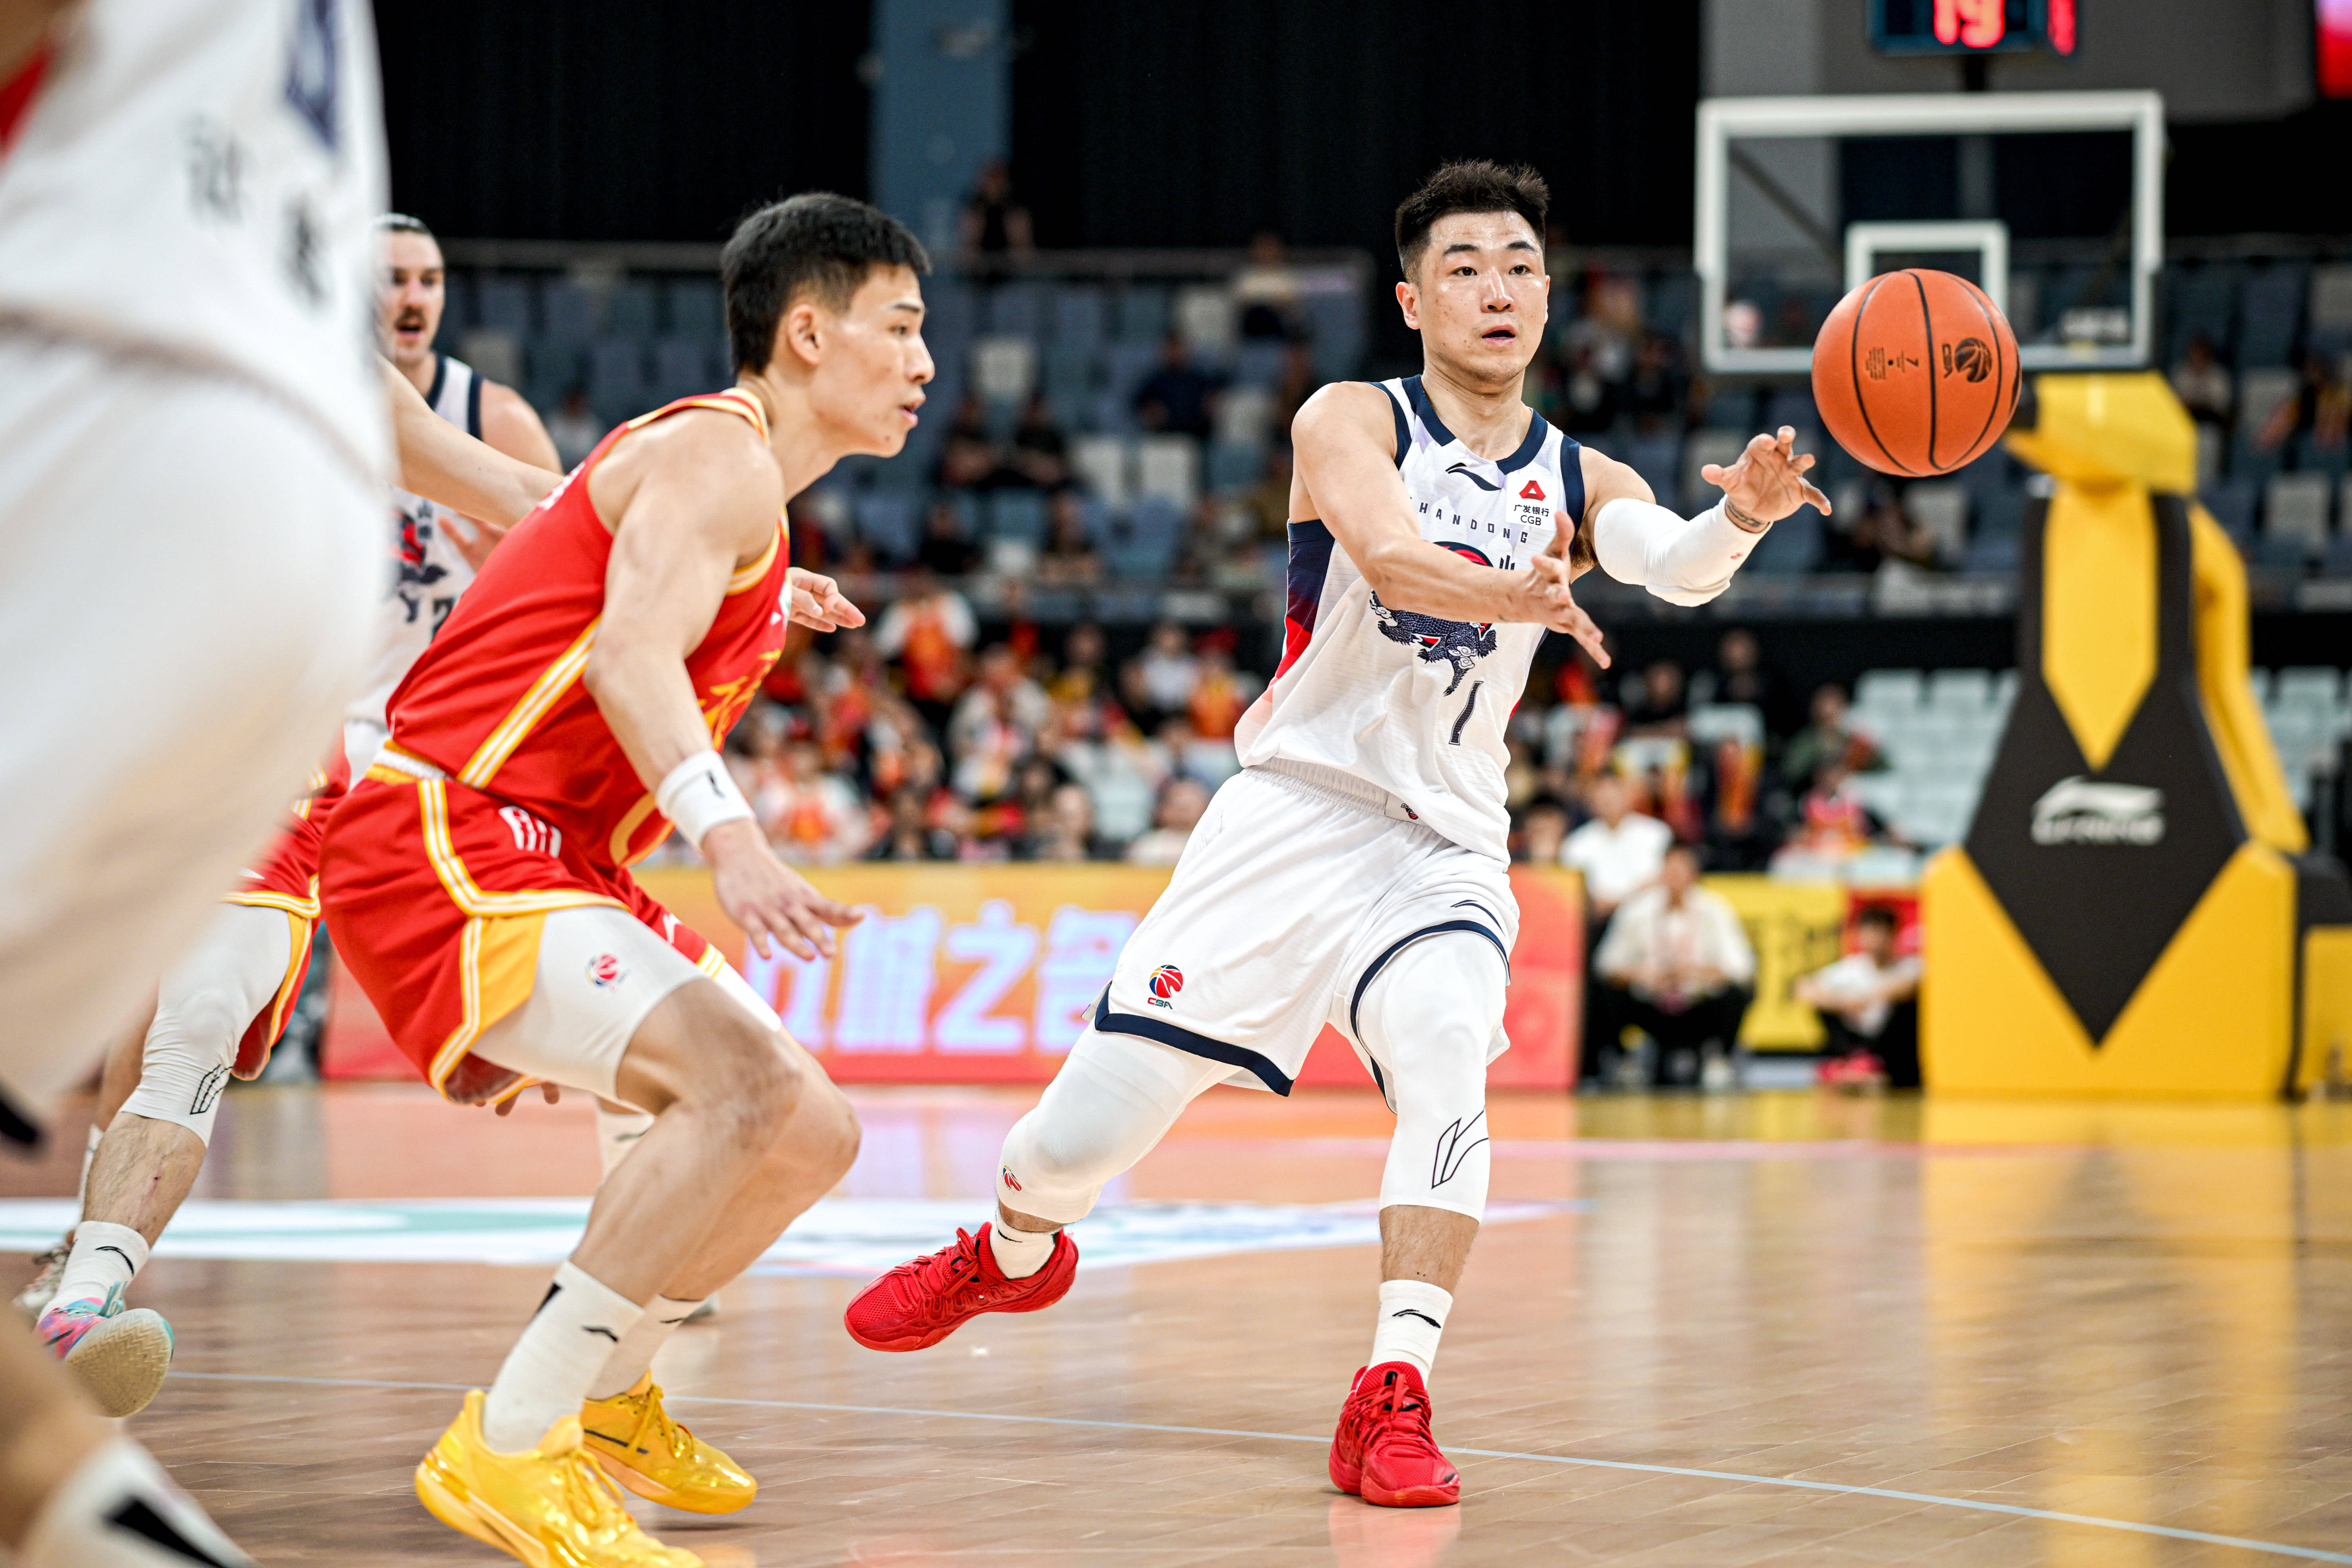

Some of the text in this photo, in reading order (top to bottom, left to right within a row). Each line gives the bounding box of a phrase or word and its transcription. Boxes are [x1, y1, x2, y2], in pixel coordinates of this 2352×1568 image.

[1514, 504, 1549, 517] 广发银行
[1410, 496, 1528, 544] HANDONG
[1520, 515, 1541, 526] CGB
[1449, 680, 1484, 746] 1
[1148, 997, 1173, 1010] CBA
